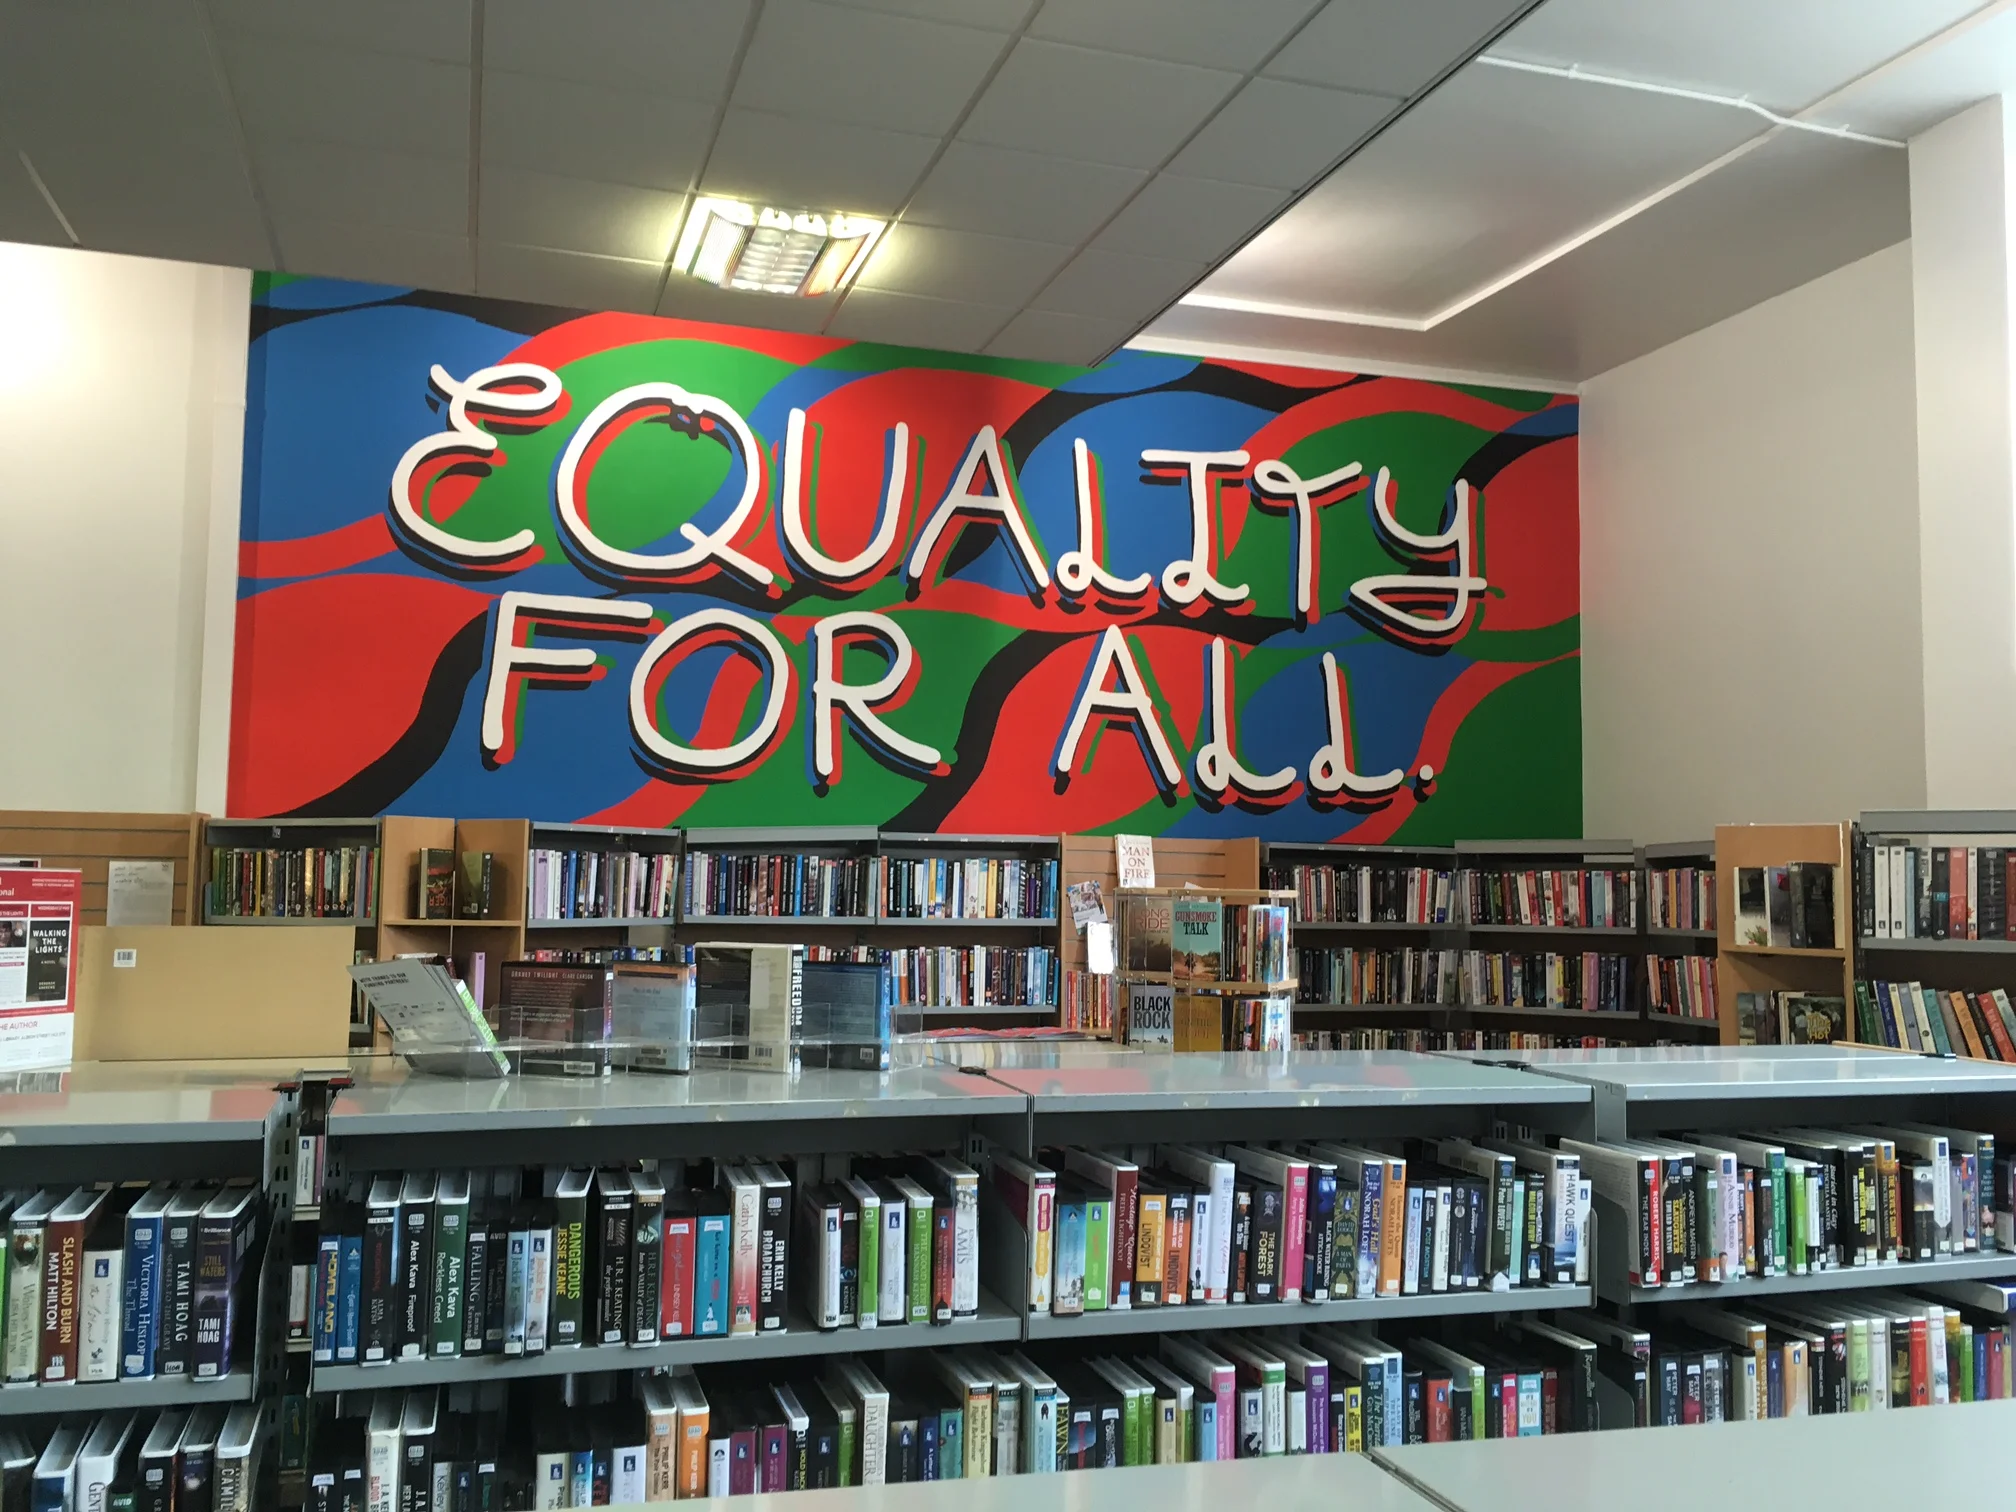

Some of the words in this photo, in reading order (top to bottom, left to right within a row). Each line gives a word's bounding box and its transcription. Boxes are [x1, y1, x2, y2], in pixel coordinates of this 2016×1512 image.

[391, 362, 1488, 632] EQUALITY
[482, 590, 941, 776] FOR
[1057, 623, 1434, 793] ALL.
[1122, 846, 1150, 856] MAN
[1128, 858, 1145, 867] ON
[1124, 870, 1150, 878] FIRE
[1176, 912, 1216, 922] GUNSMOKE
[1183, 923, 1209, 935] TALK
[792, 969, 803, 1026] FREEDOM
[1134, 996, 1171, 1011] BLACK
[9, 1021, 38, 1030] AUTHOR
[1134, 1012, 1171, 1029] ROCK
[1566, 1173, 1575, 1205] HAWK
[1830, 1197, 1836, 1207] in
[1362, 1192, 1371, 1228] NORAH
[1372, 1198, 1380, 1228] Gad's
[1497, 1205, 1505, 1231] LOVESEY
[1528, 1190, 1536, 1220] MALCOLM
[1830, 1209, 1838, 1229] Clay
[1565, 1208, 1574, 1243] QUEST
[62, 1237, 74, 1275] SLASH
[409, 1240, 419, 1262] Alex
[557, 1228, 567, 1259] JESSIE
[775, 1240, 785, 1261] ERIN
[957, 1227, 968, 1264] AMIS
[1125, 1234, 1135, 1270] Queen
[1140, 1223, 1152, 1268] LINDQVIST
[1257, 1231, 1268, 1276] FOREST
[1361, 1230, 1369, 1260] LOFTS
[1370, 1232, 1379, 1253] Hall
[48, 1252, 59, 1283] MATT
[200, 1266, 226, 1278] WATERS
[203, 1255, 222, 1265] STILL
[435, 1252, 444, 1293] Reckless
[448, 1256, 460, 1283] Alex
[469, 1245, 482, 1302] FALLING
[511, 1256, 522, 1284] Jackie
[568, 1223, 582, 1299] DANGEROUS
[761, 1230, 772, 1303] BROADCHURCH
[1167, 1250, 1180, 1294] LINDQVIST
[125, 1278, 137, 1297] The
[177, 1261, 190, 1296] TAMI
[324, 1251, 337, 1333] HOMELAND
[408, 1265, 418, 1289] Kava
[556, 1262, 567, 1295] KEANE
[604, 1276, 612, 1298] perfect
[637, 1274, 645, 1298] VALLEY
[774, 1264, 784, 1291] KELLY
[61, 1279, 73, 1306] AND
[165, 1291, 172, 1302] TO
[447, 1287, 459, 1318] Kava
[635, 1299, 644, 1307] of
[645, 1283, 655, 1329] KEATING
[46, 1286, 58, 1331] HILTON
[124, 1300, 135, 1332] Thread
[176, 1302, 188, 1342] HOAG
[406, 1295, 416, 1333] Fireproof
[433, 1295, 443, 1324] Creed
[60, 1308, 71, 1343] BURN
[196, 1331, 220, 1344] HOAG
[198, 1317, 221, 1331] TAMI
[473, 1312, 481, 1336] Emma
[865, 1405, 878, 1477] DAUGHTER
[112, 1497, 132, 1506] AVID
